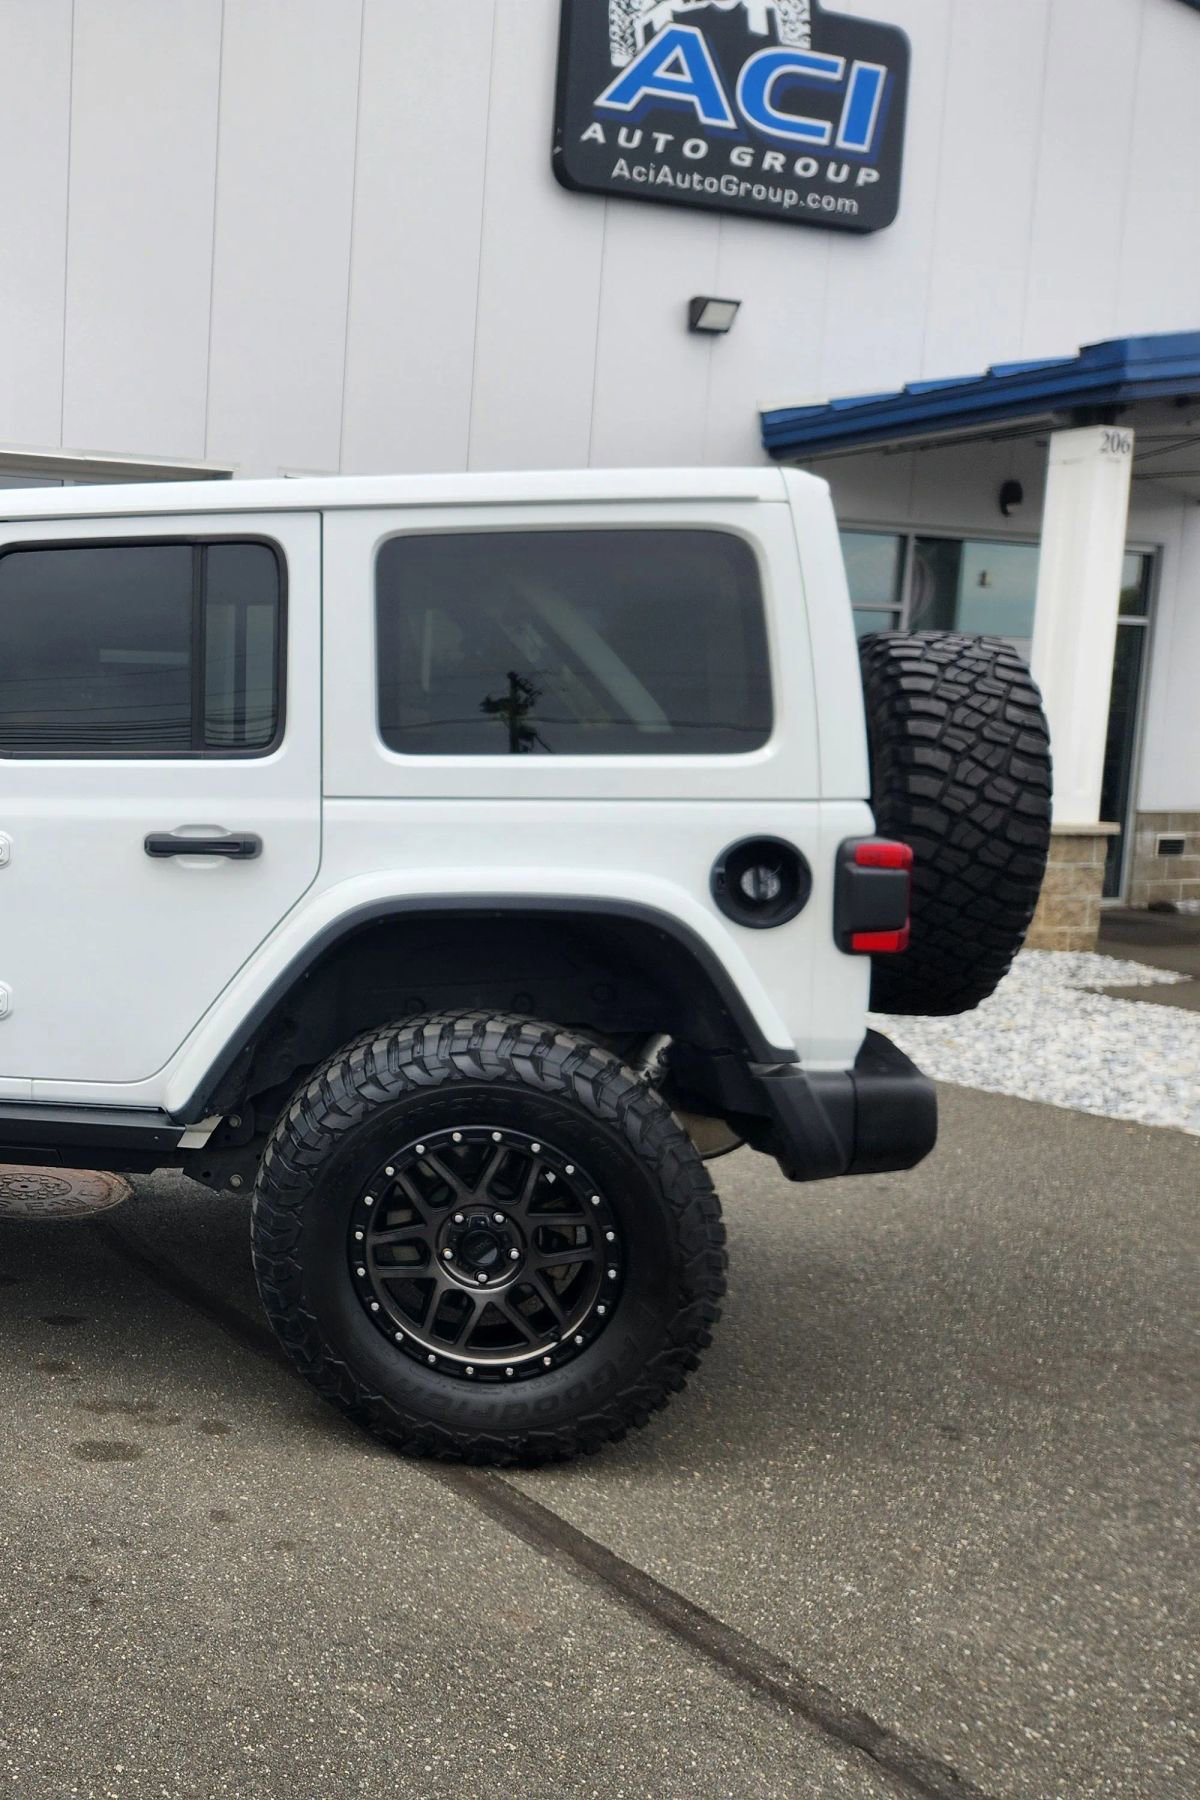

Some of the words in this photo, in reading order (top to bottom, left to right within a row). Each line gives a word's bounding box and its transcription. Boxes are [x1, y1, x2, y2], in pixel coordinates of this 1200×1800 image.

[593, 22, 888, 153] ACI
[580, 121, 709, 160] AUTO
[729, 145, 881, 187] GROUP
[611, 158, 859, 215] AciAutoGroup.com
[1099, 430, 1131, 455] 206
